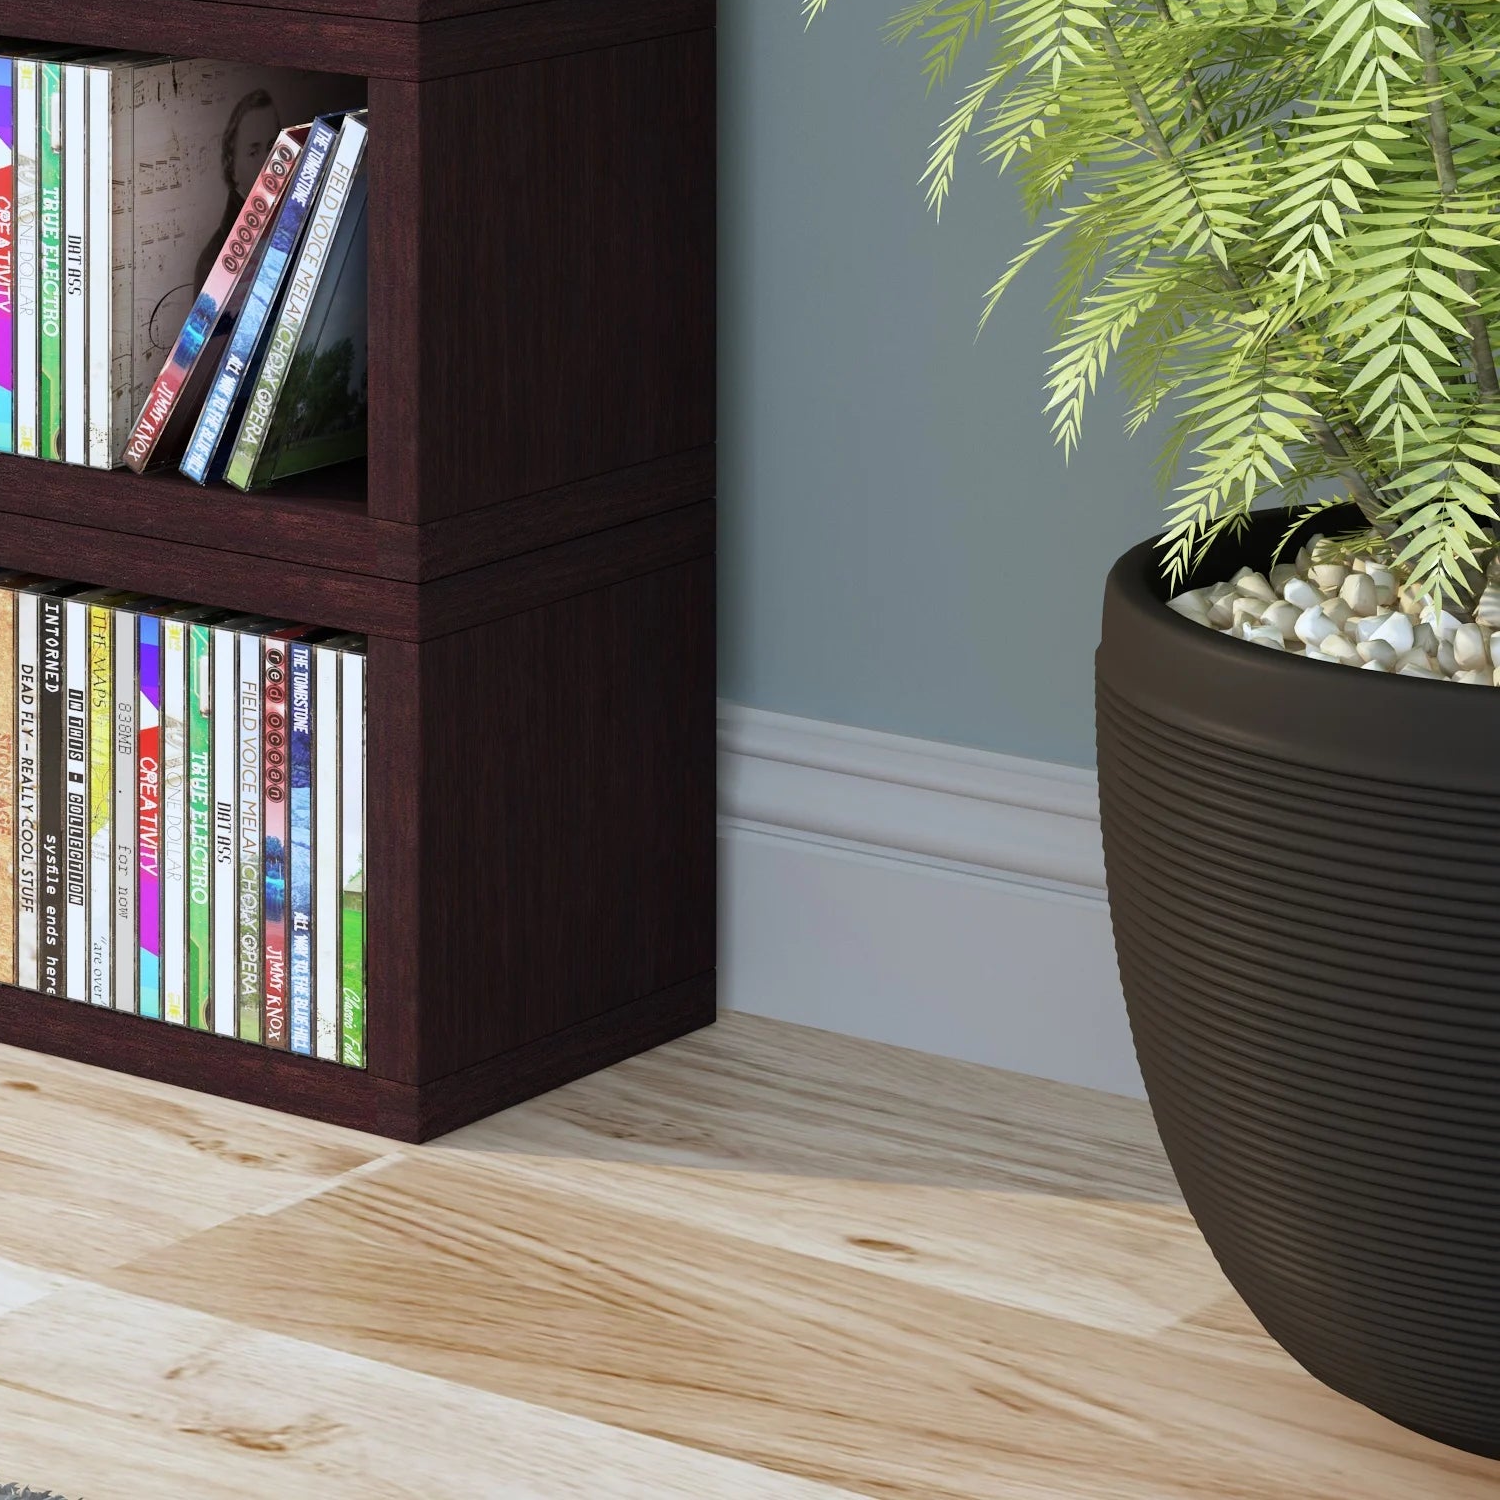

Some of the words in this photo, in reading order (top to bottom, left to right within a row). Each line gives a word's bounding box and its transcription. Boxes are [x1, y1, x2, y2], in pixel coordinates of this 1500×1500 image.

[292, 148, 325, 208] TOMBSTONE
[324, 161, 350, 210] FIELD
[43, 187, 58, 239] TRUE
[303, 214, 334, 268] VOICE
[43, 244, 58, 337] ELECTRO
[68, 689, 83, 710] IN
[242, 681, 257, 731] FIELD
[294, 671, 309, 733] TOMBSTONE
[68, 716, 83, 761] THIS
[242, 737, 257, 793] VOICE
[267, 712, 283, 803] ocean
[192, 752, 207, 804] TRUE
[141, 757, 157, 877] CREATIVITY
[68, 793, 83, 906] COLLECTION
[118, 844, 132, 876] for
[192, 808, 207, 905] ELECTRO
[118, 887, 132, 919] now
